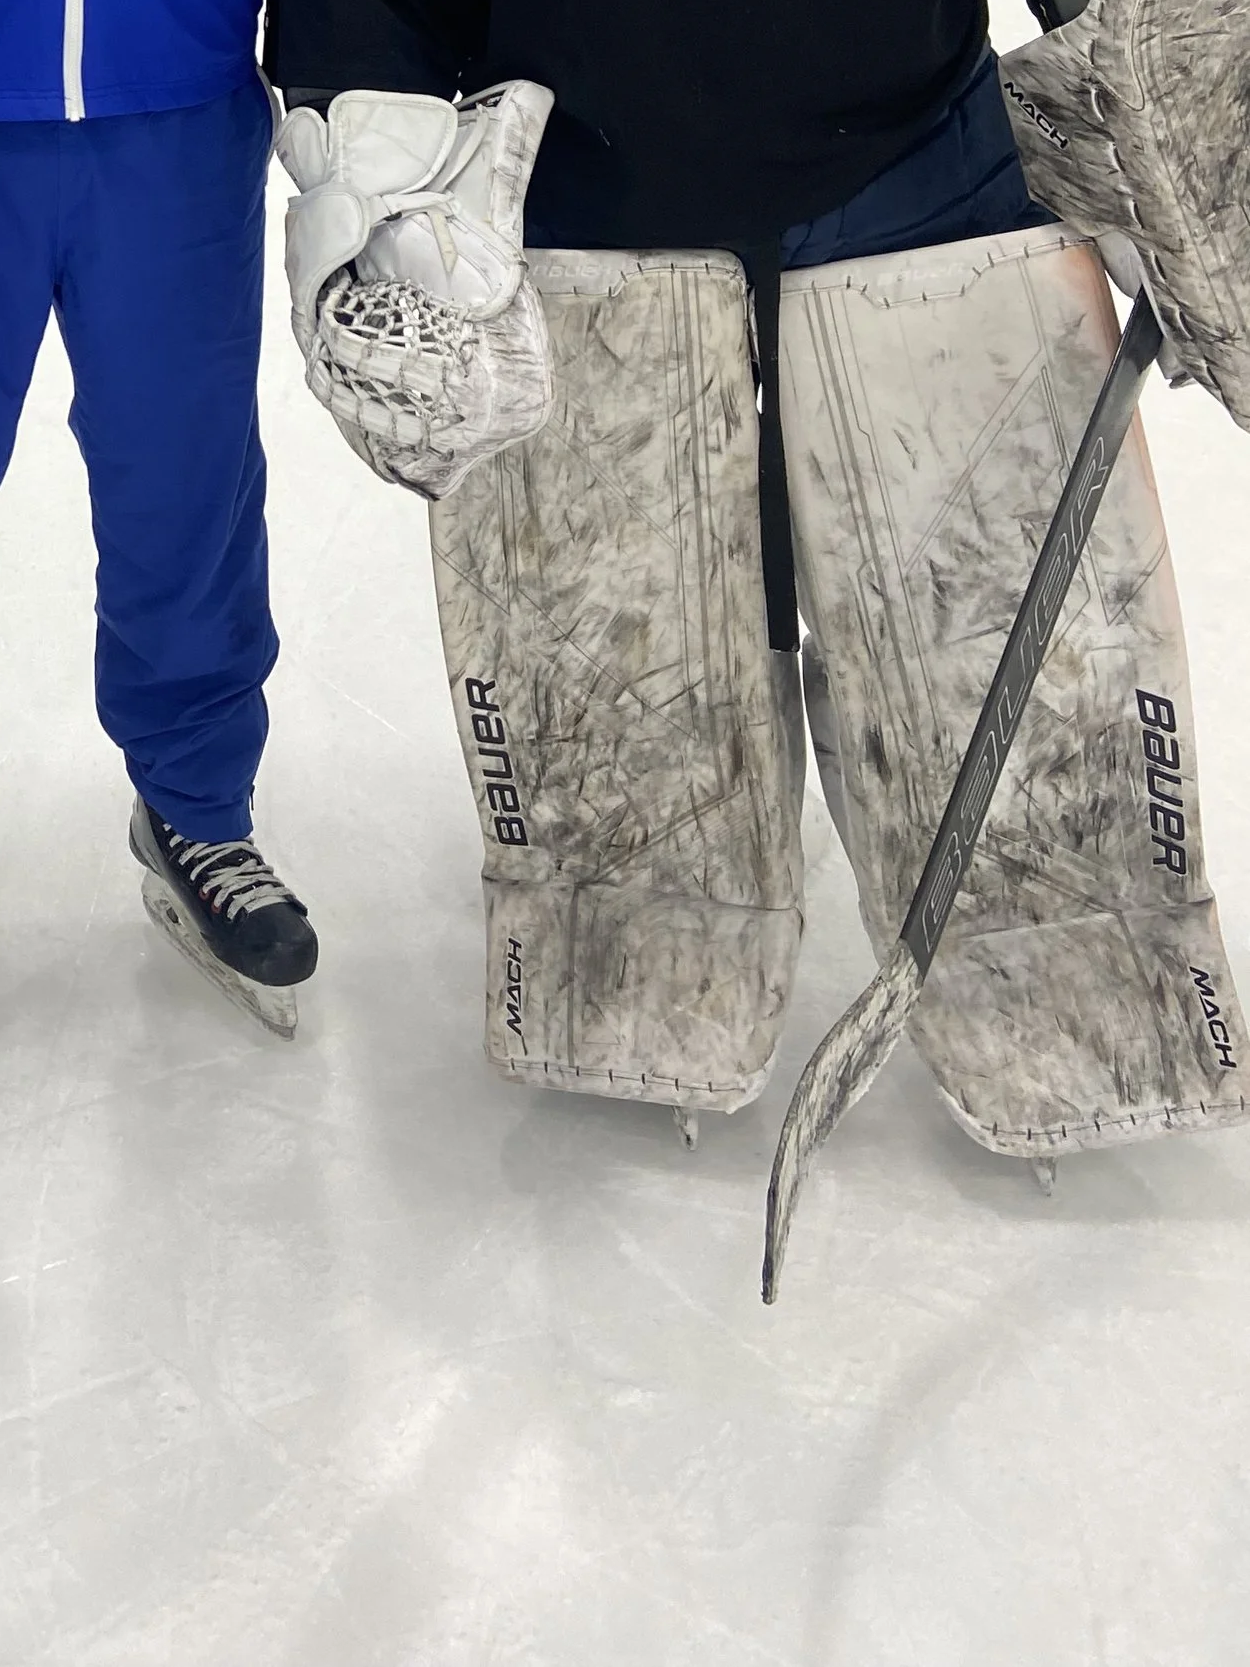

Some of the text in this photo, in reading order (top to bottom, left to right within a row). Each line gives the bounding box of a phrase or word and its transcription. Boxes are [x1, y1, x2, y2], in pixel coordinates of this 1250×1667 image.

[1003, 80, 1068, 150] MACH
[507, 938, 523, 1036] MACH
[1189, 966, 1237, 1068] MACH
